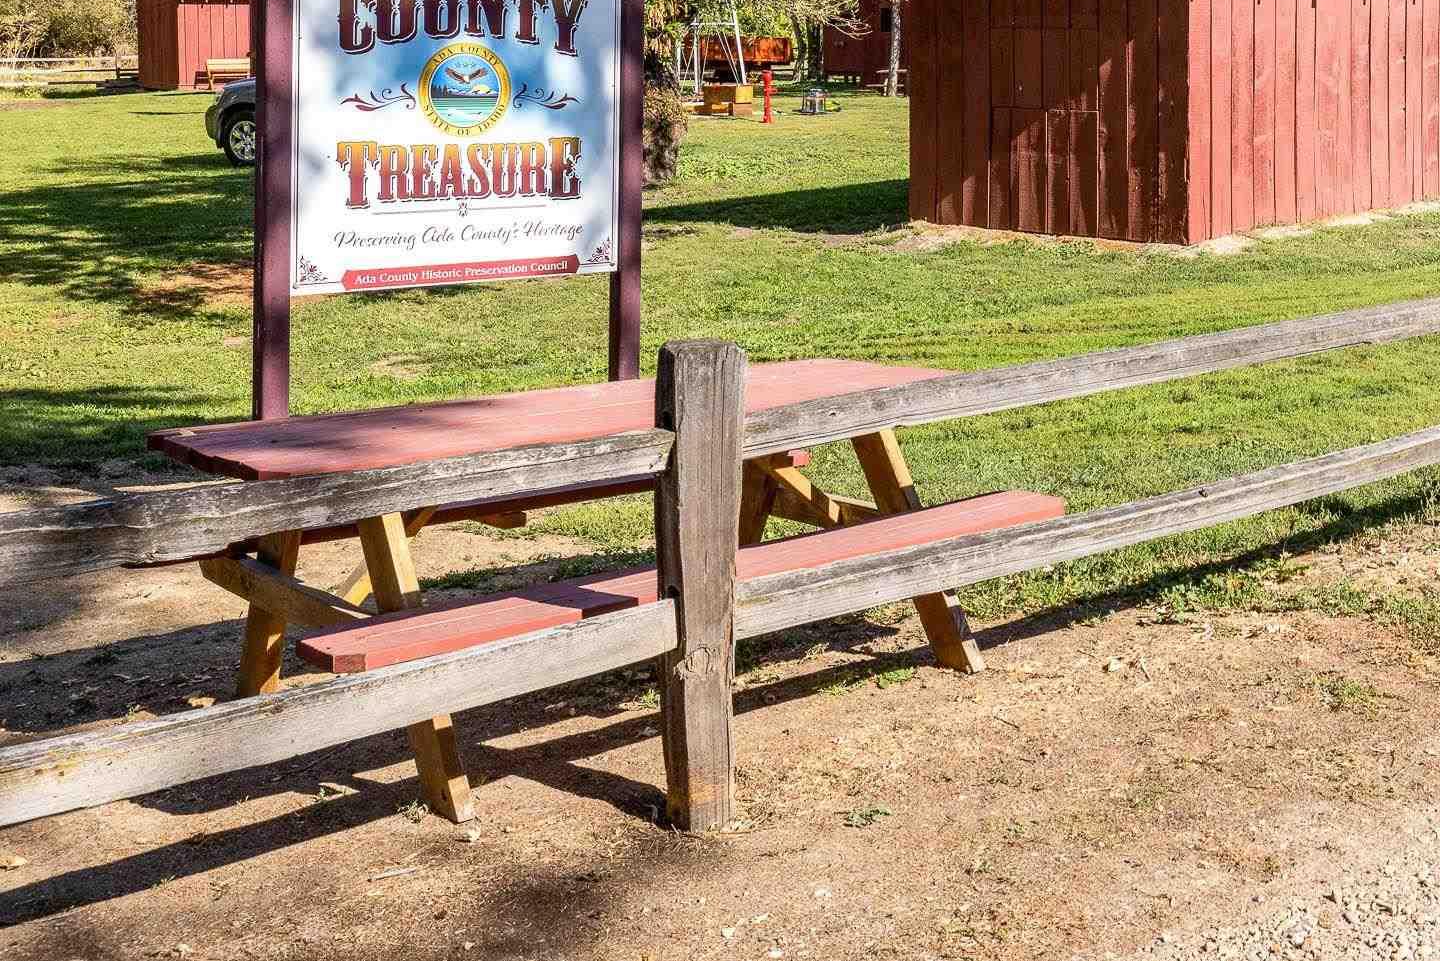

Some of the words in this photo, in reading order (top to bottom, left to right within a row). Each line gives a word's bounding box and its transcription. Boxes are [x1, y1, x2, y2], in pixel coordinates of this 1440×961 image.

[433, 48, 454, 65] ADA
[336, 136, 584, 210] TREASURE
[333, 231, 417, 250] Preserving
[422, 225, 455, 244] Ada
[523, 220, 584, 241] Heritage
[354, 274, 377, 284] Ada
[380, 271, 418, 283] County
[422, 268, 462, 279] Historic
[464, 264, 528, 276] Preservation
[530, 260, 568, 272] Council
